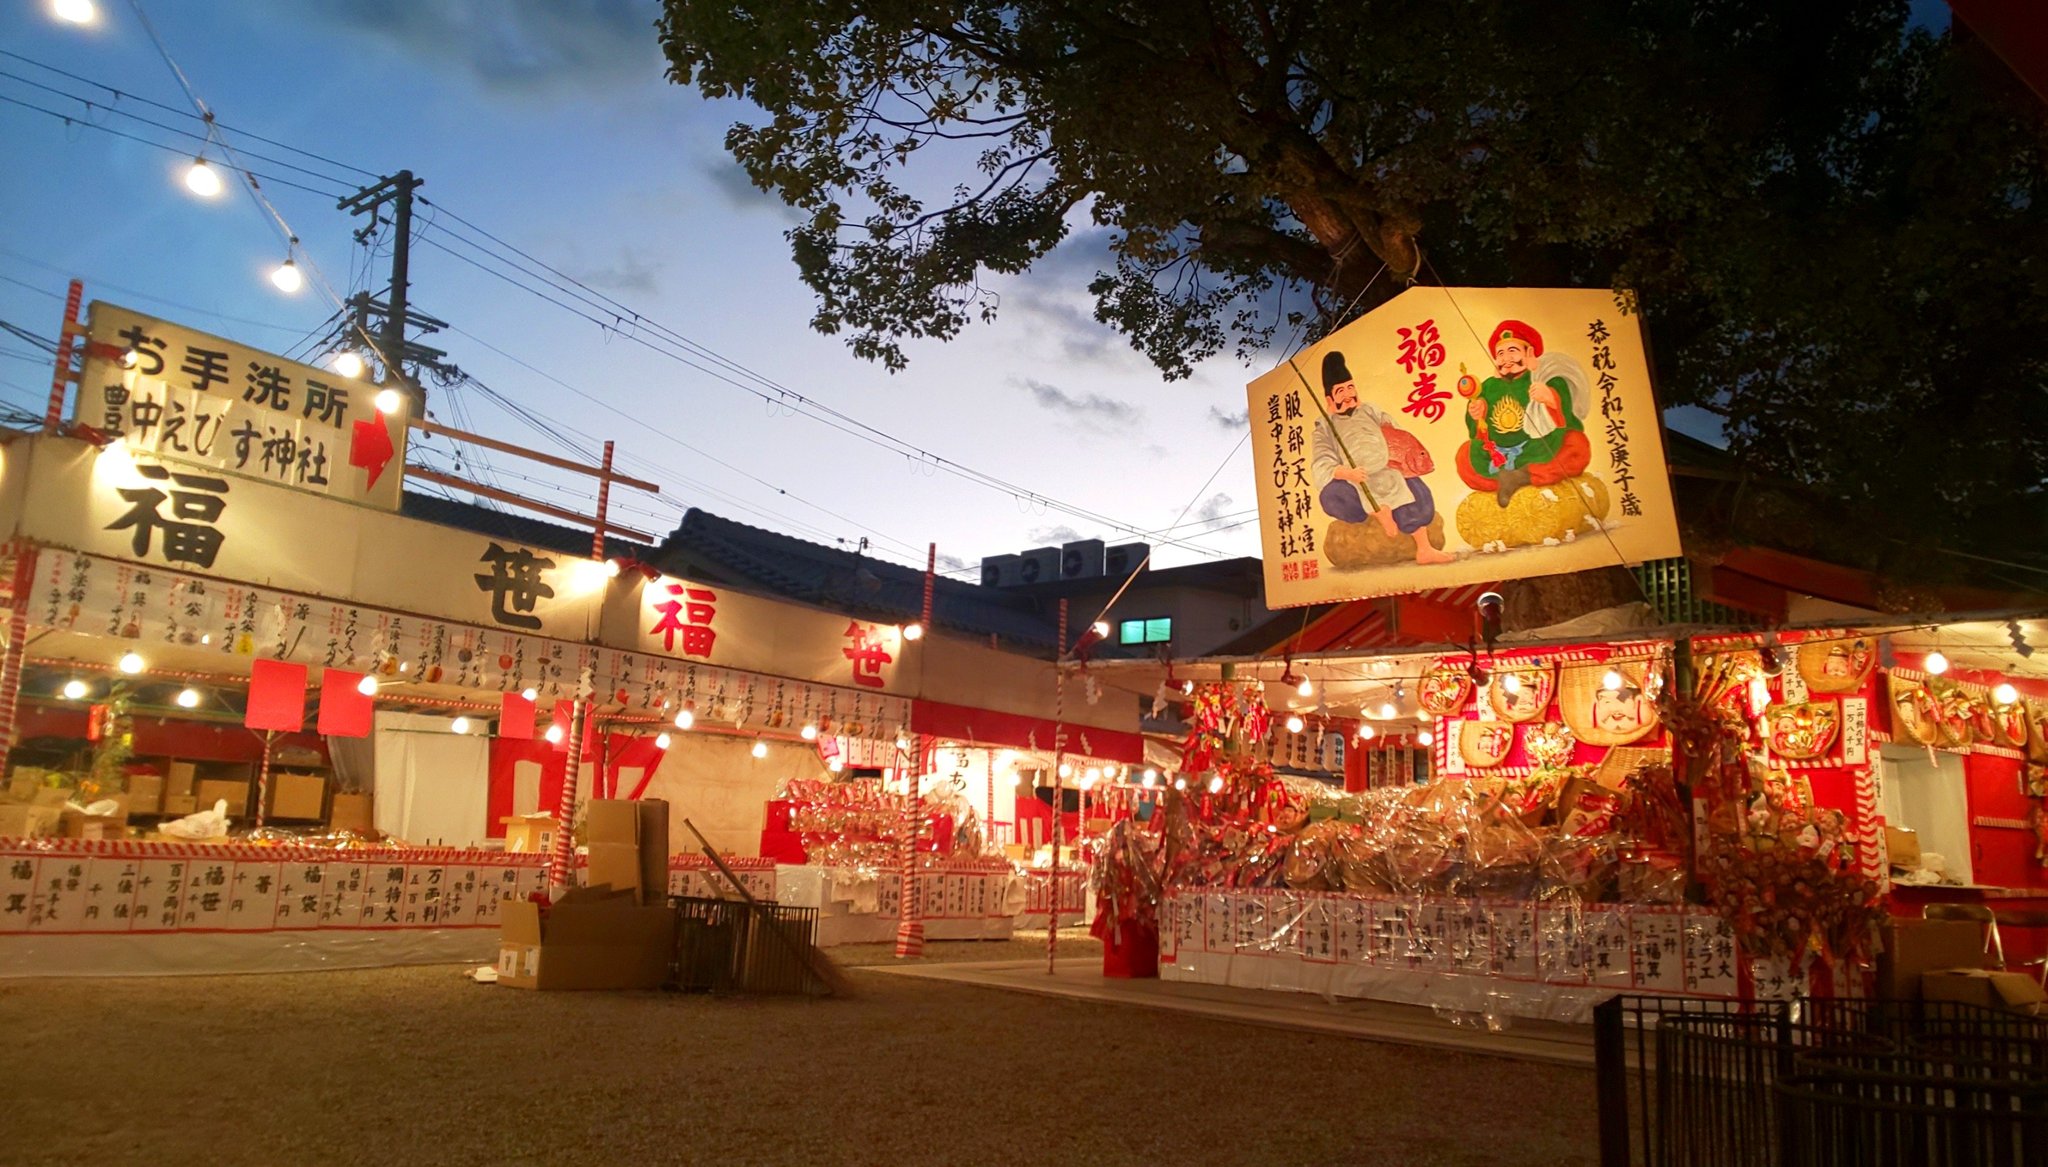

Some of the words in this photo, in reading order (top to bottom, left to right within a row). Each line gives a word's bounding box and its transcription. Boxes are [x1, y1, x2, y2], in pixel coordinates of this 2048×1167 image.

[118, 325, 350, 430] お手洗所
[1396, 318, 1454, 423] 福寿
[101, 383, 329, 486] 豊中えびす神社
[1267, 394, 1300, 559] 豊中えびす神社
[1284, 390, 1316, 555] 服部天神宮
[105, 463, 230, 569] 福
[473, 541, 556, 631] 笹
[650, 584, 717, 659] 福
[301, 866, 322, 914] 福袋
[405, 873, 420, 924] 五百円
[422, 868, 443, 923] 万両判
